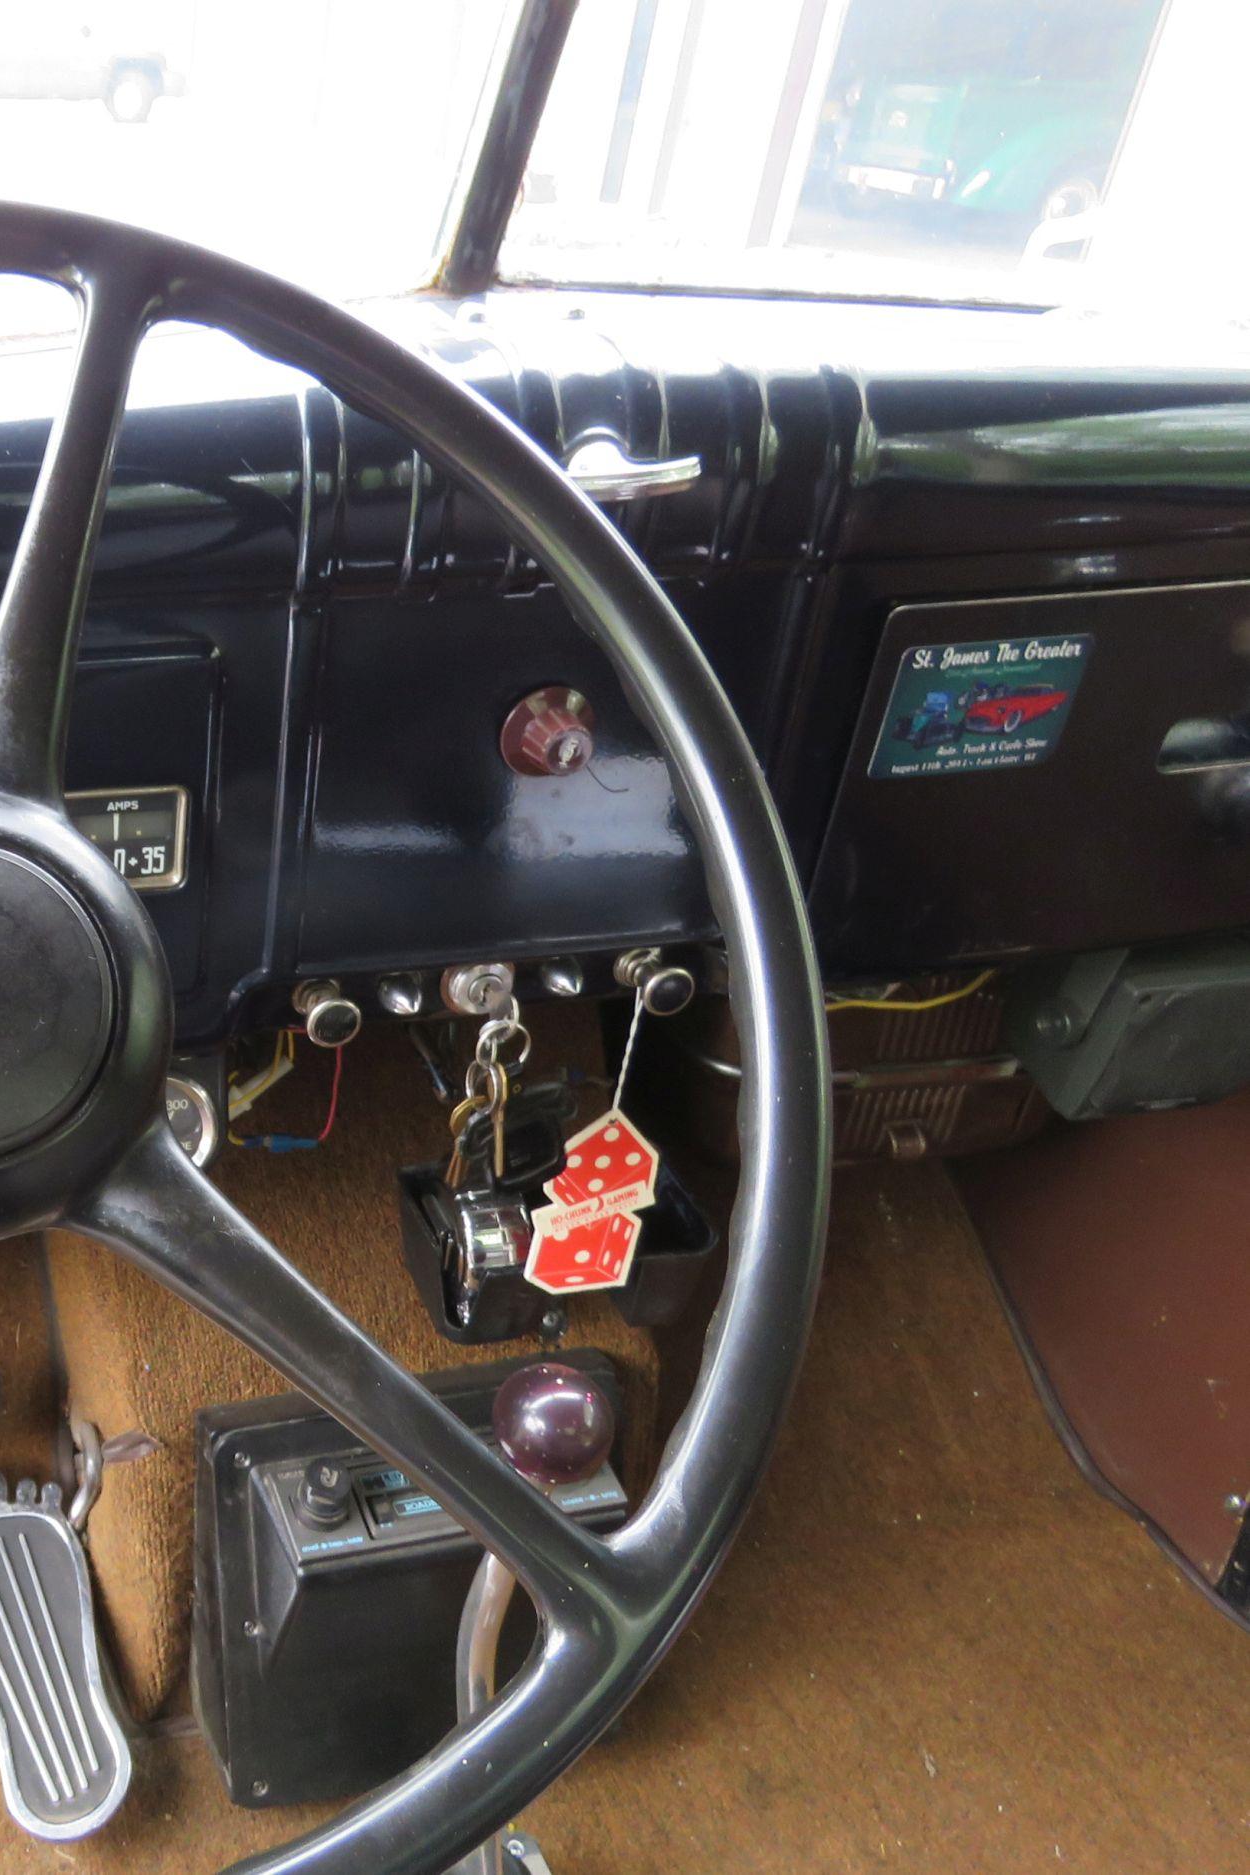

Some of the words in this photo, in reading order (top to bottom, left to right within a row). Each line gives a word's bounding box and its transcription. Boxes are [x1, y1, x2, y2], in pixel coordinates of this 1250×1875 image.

[912, 649, 933, 670] St.
[940, 647, 990, 670] James
[996, 643, 1019, 663] The
[1024, 640, 1082, 660] Greater
[106, 800, 139, 812] AMPS
[140, 845, 166, 875] 35
[607, 1188, 640, 1206] GAMING
